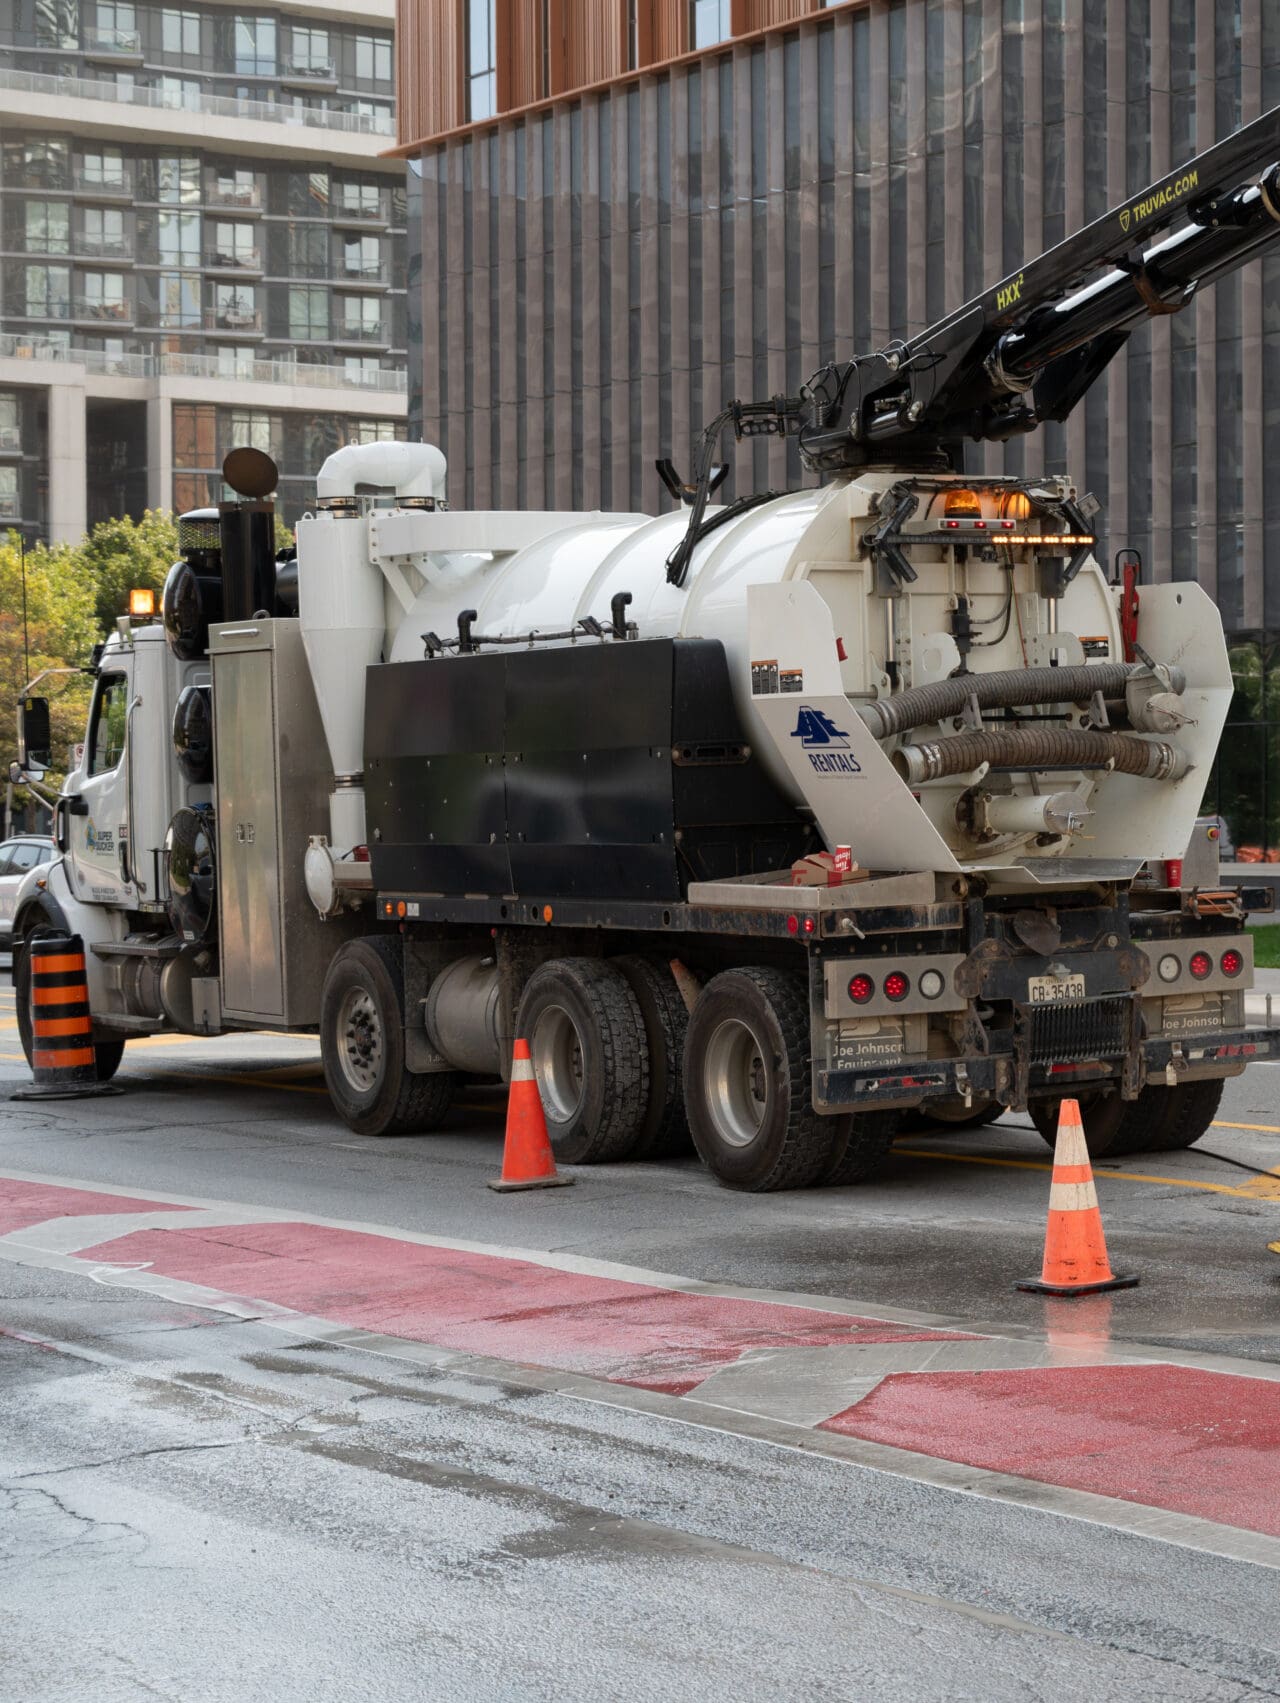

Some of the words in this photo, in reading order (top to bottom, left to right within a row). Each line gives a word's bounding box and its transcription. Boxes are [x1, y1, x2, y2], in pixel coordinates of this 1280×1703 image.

[1133, 171, 1198, 222] TRUVAC.COM
[808, 754, 861, 772] RENTALS
[833, 1045, 854, 1057] Joe
